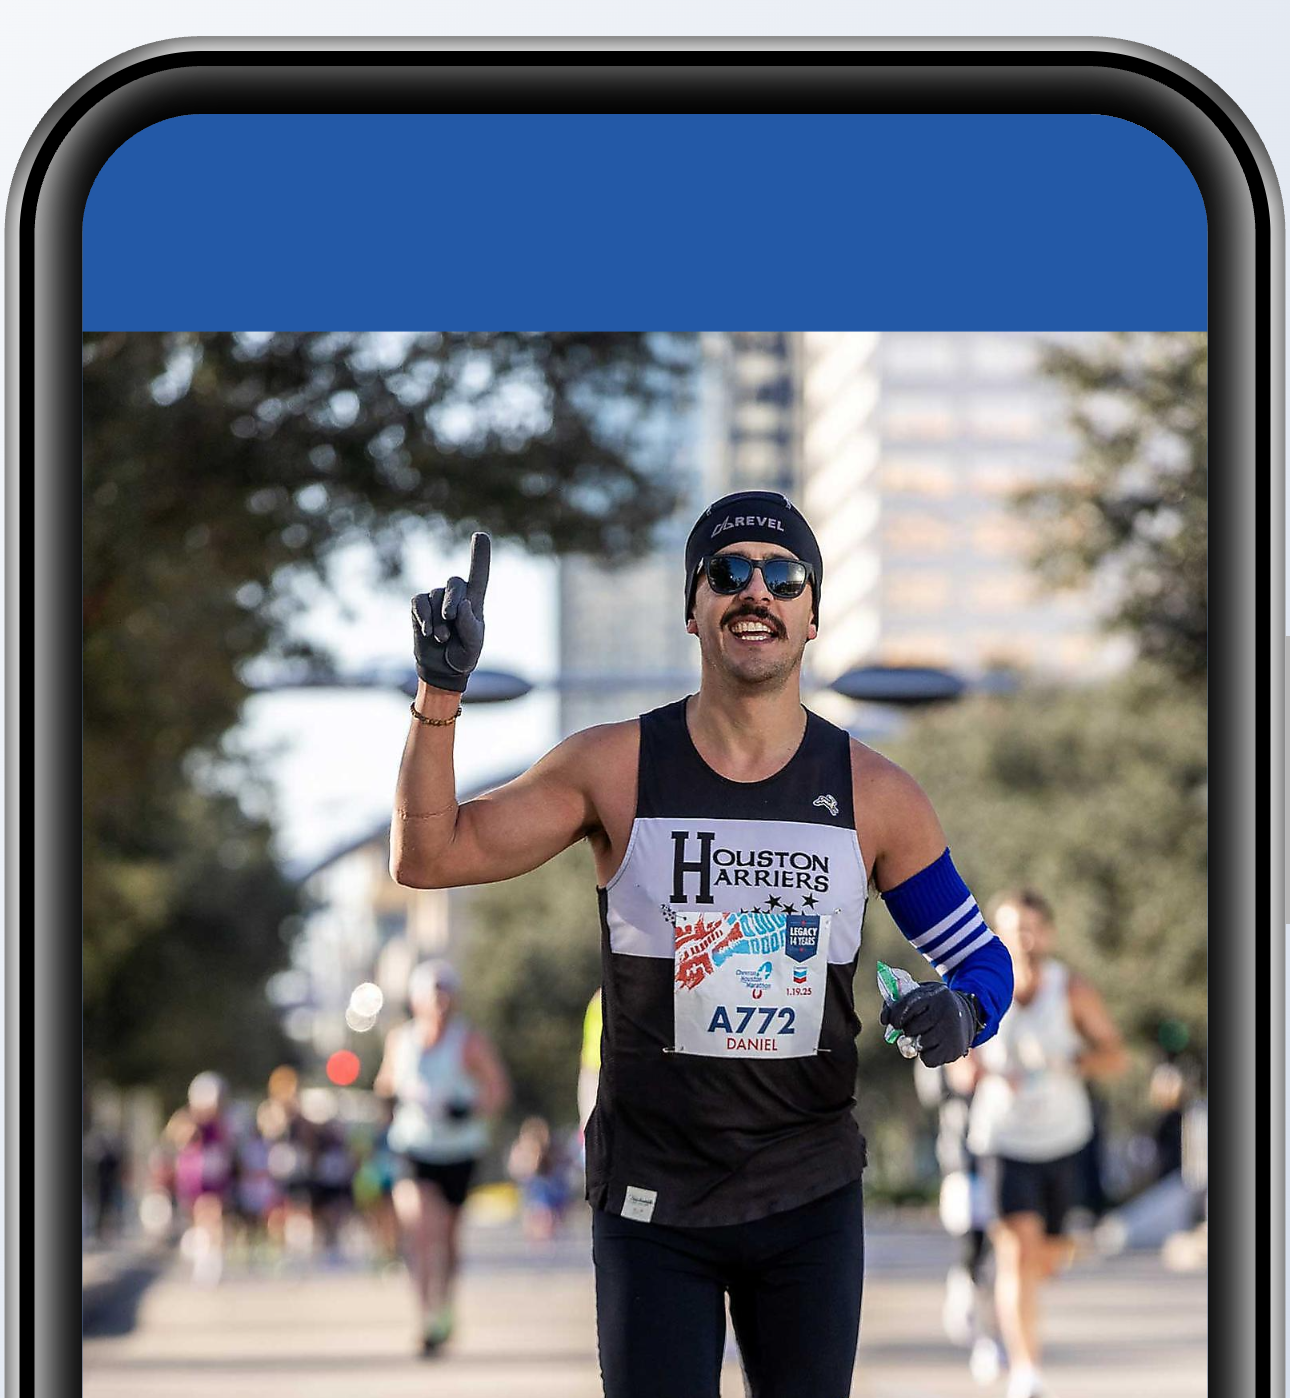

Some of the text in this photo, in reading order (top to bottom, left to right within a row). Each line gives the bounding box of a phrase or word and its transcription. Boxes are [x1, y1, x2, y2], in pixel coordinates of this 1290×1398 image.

[735, 516, 785, 532] REVEL
[790, 926, 818, 936] LEGACY
[790, 936, 815, 946] 14 YEARS
[786, 987, 812, 996] 1.19.25
[707, 1006, 796, 1034] A772
[727, 1038, 777, 1051] DANIEL
